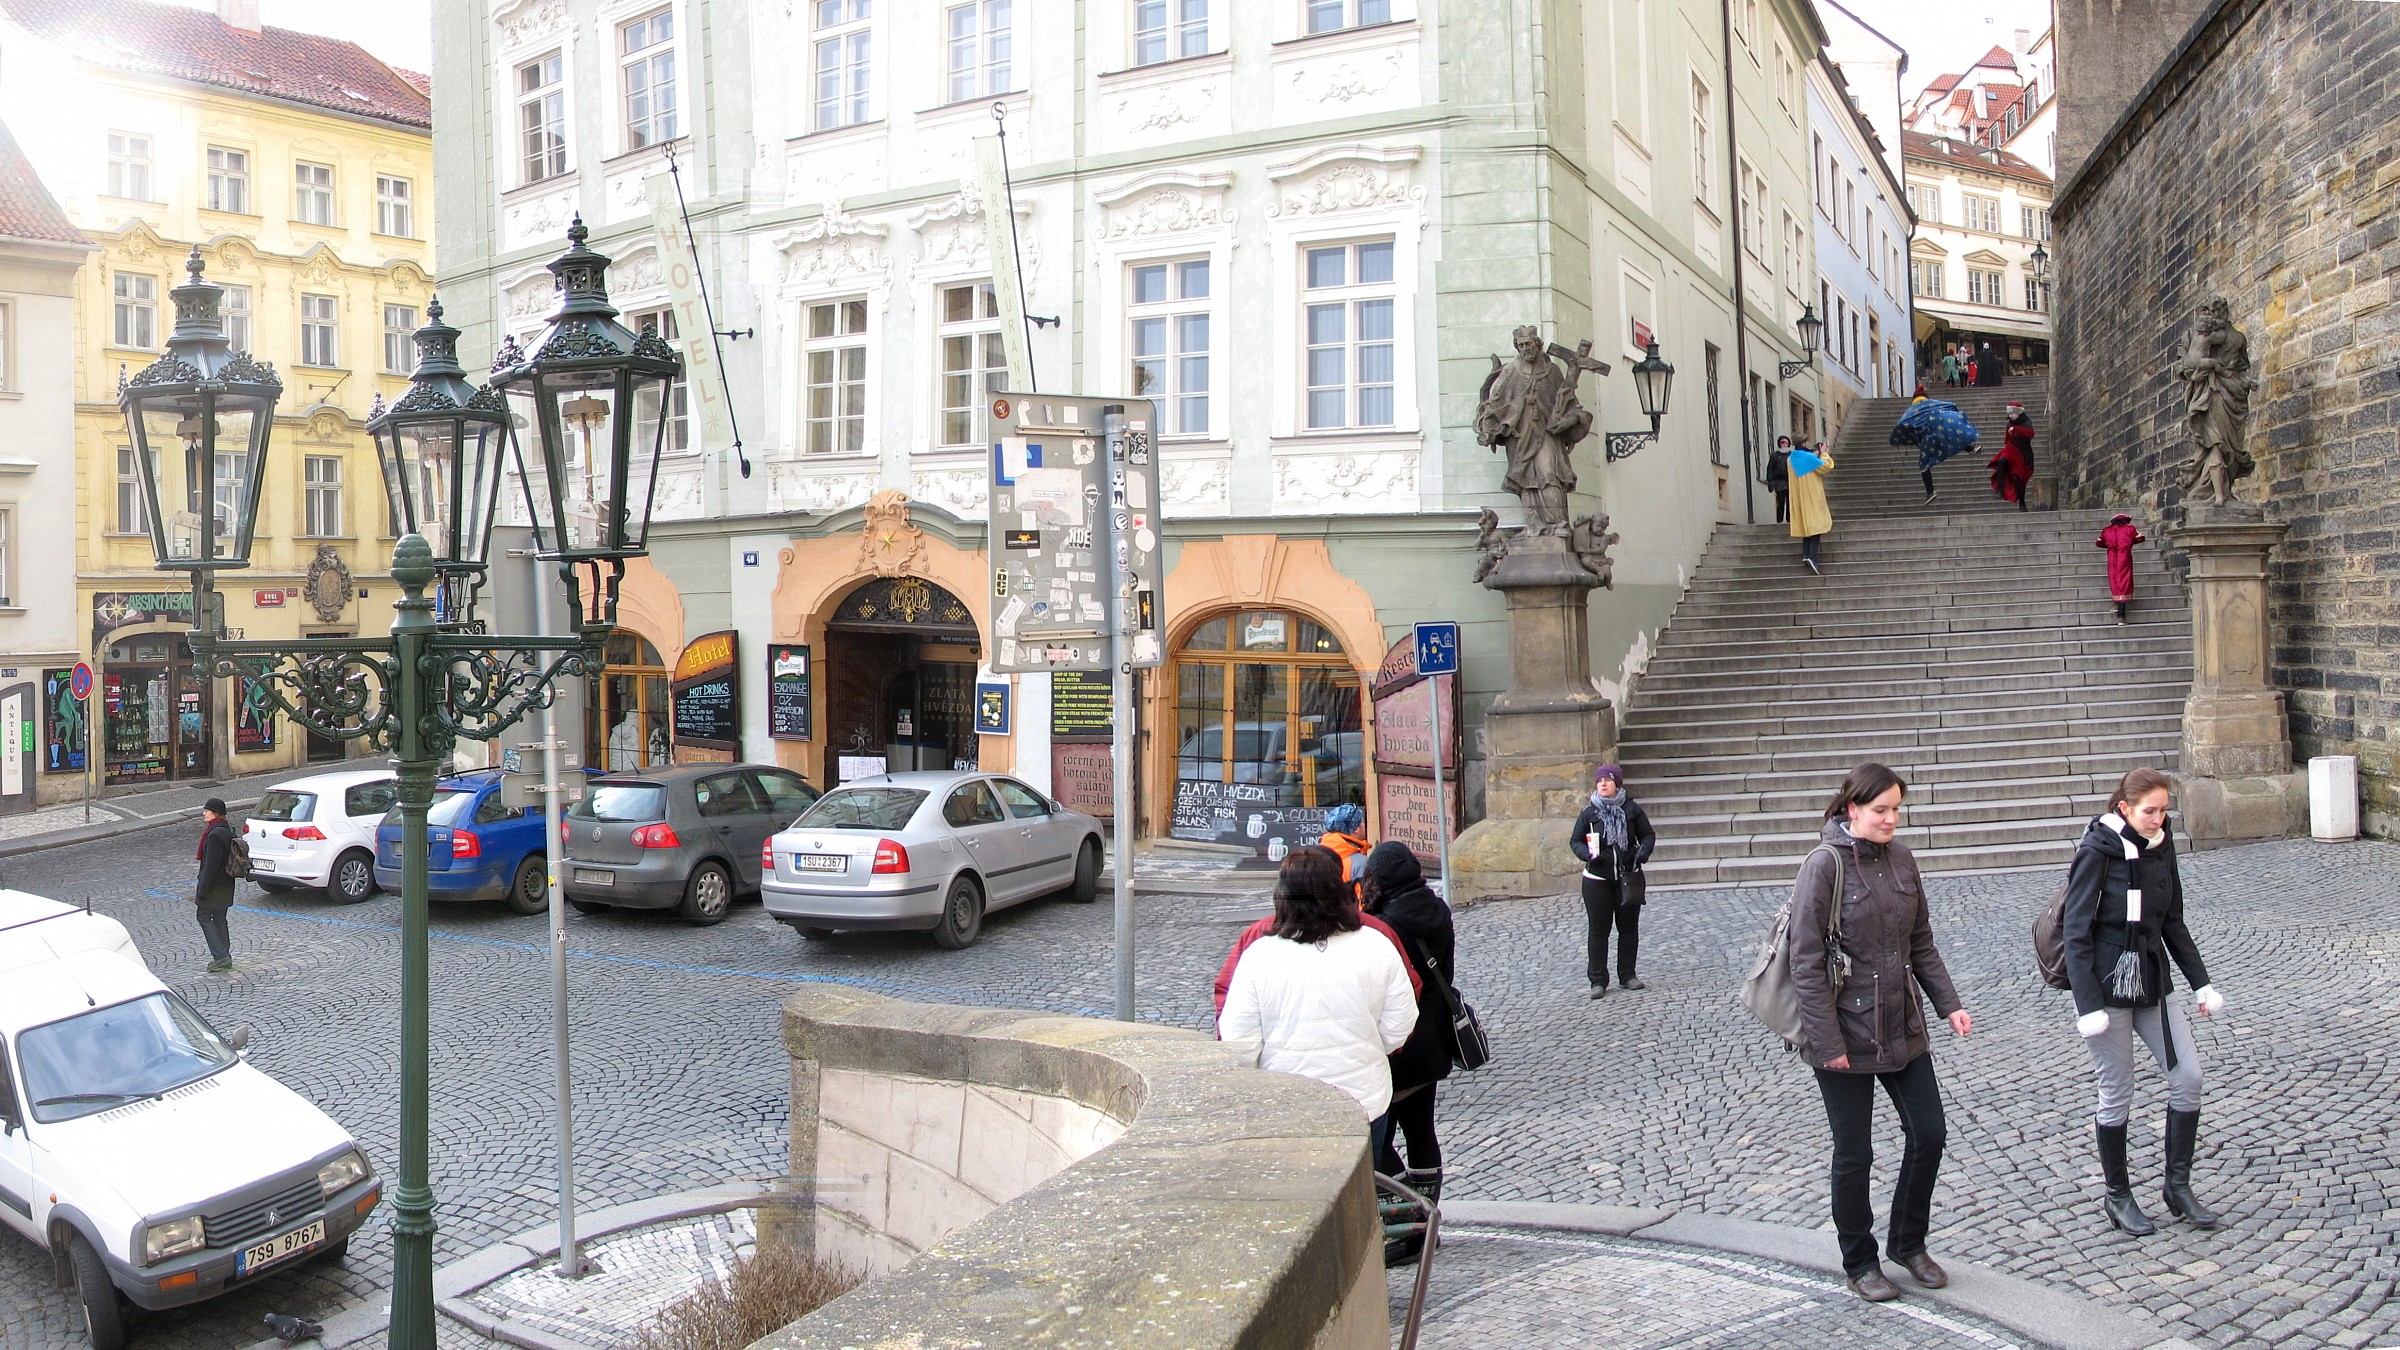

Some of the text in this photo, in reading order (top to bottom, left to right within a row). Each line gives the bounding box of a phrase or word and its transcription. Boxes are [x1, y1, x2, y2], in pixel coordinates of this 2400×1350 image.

[660, 223, 716, 404] HOTEL
[746, 553, 755, 564] 48
[684, 636, 730, 675] Hotel
[1382, 651, 1415, 681] Resta
[689, 682, 729, 698] HOT DRINKS
[774, 682, 807, 694] EXCHANGE
[929, 686, 966, 699] ZLATÁ
[778, 695, 793, 706] 0%
[923, 700, 973, 714] HVĚZDA
[773, 705, 804, 715] COMMISSION
[1387, 782, 1451, 800] czech draut
[1408, 798, 1428, 811] beer
[1388, 807, 1412, 823] czech
[1389, 824, 1451, 844] fresh salas
[803, 856, 842, 868] 1SU 2367
[248, 1242, 274, 1267] 7S9
[284, 1224, 318, 1251] 8767
